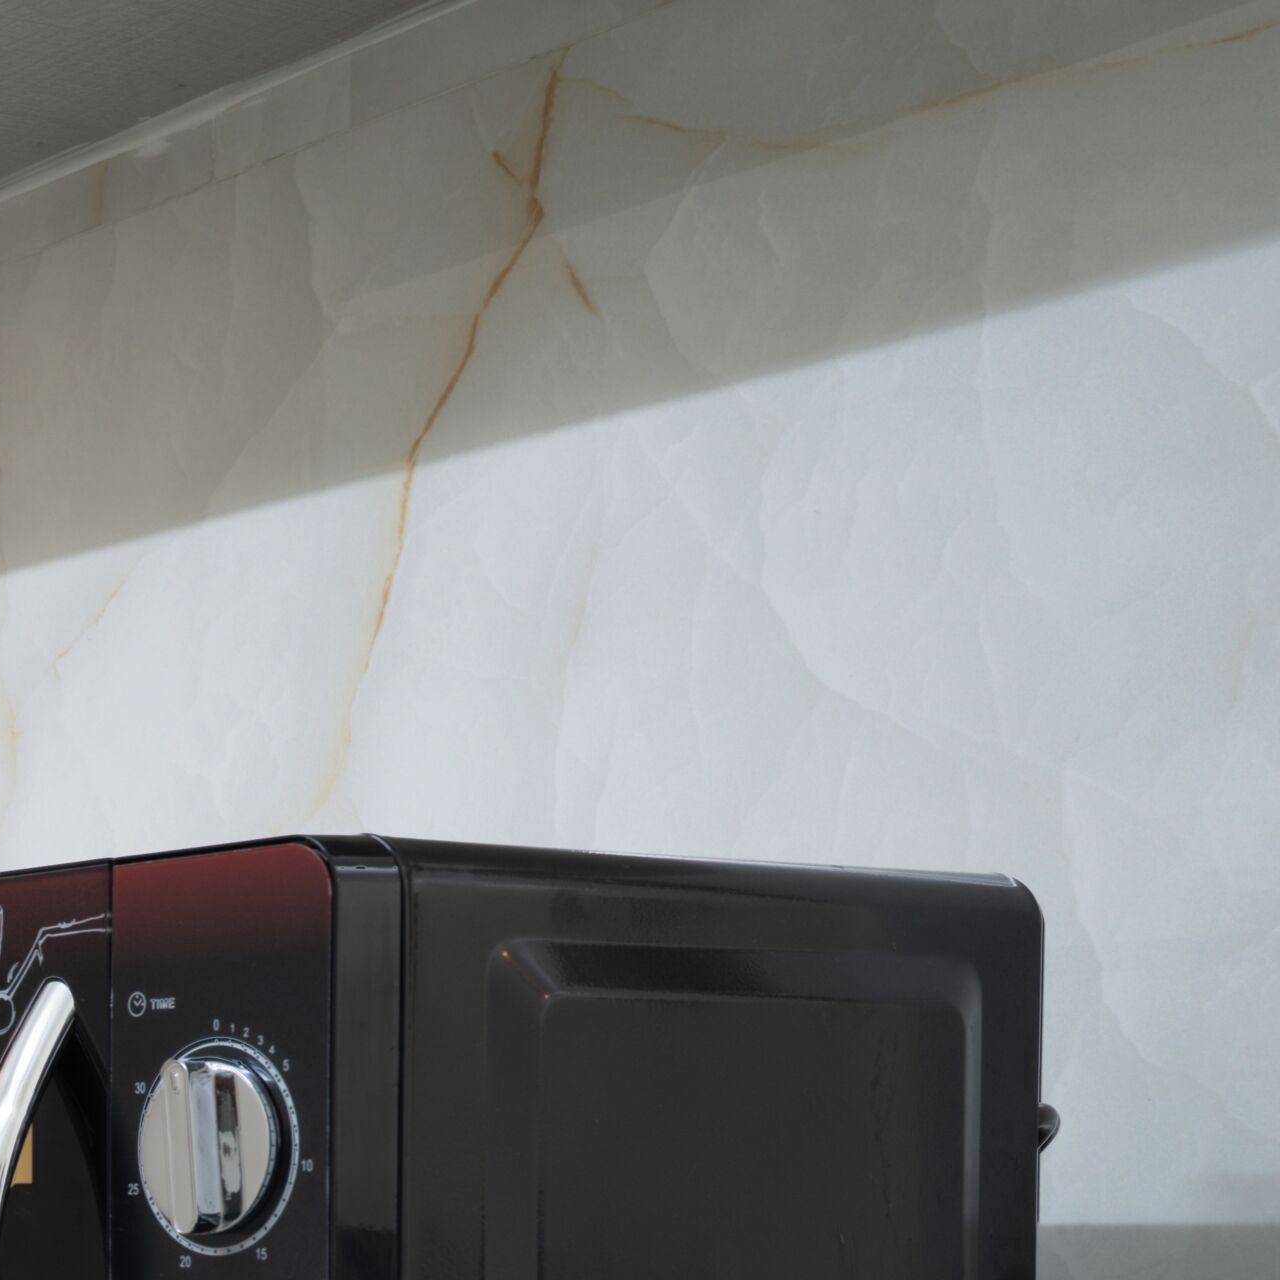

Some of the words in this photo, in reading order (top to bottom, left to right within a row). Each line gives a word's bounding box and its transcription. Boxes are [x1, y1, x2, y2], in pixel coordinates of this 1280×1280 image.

[149, 997, 176, 1010] TIME
[213, 1018, 220, 1031] 0
[230, 1024, 235, 1033] 1
[243, 1027, 250, 1038] 2
[257, 1035, 264, 1045] 3
[268, 1044, 276, 1055] 4
[282, 1059, 290, 1072] 5
[134, 1081, 146, 1094] 30
[301, 1159, 314, 1172] 10
[128, 1183, 139, 1196] 25
[256, 1247, 268, 1261] 15
[179, 1255, 191, 1268] 20
